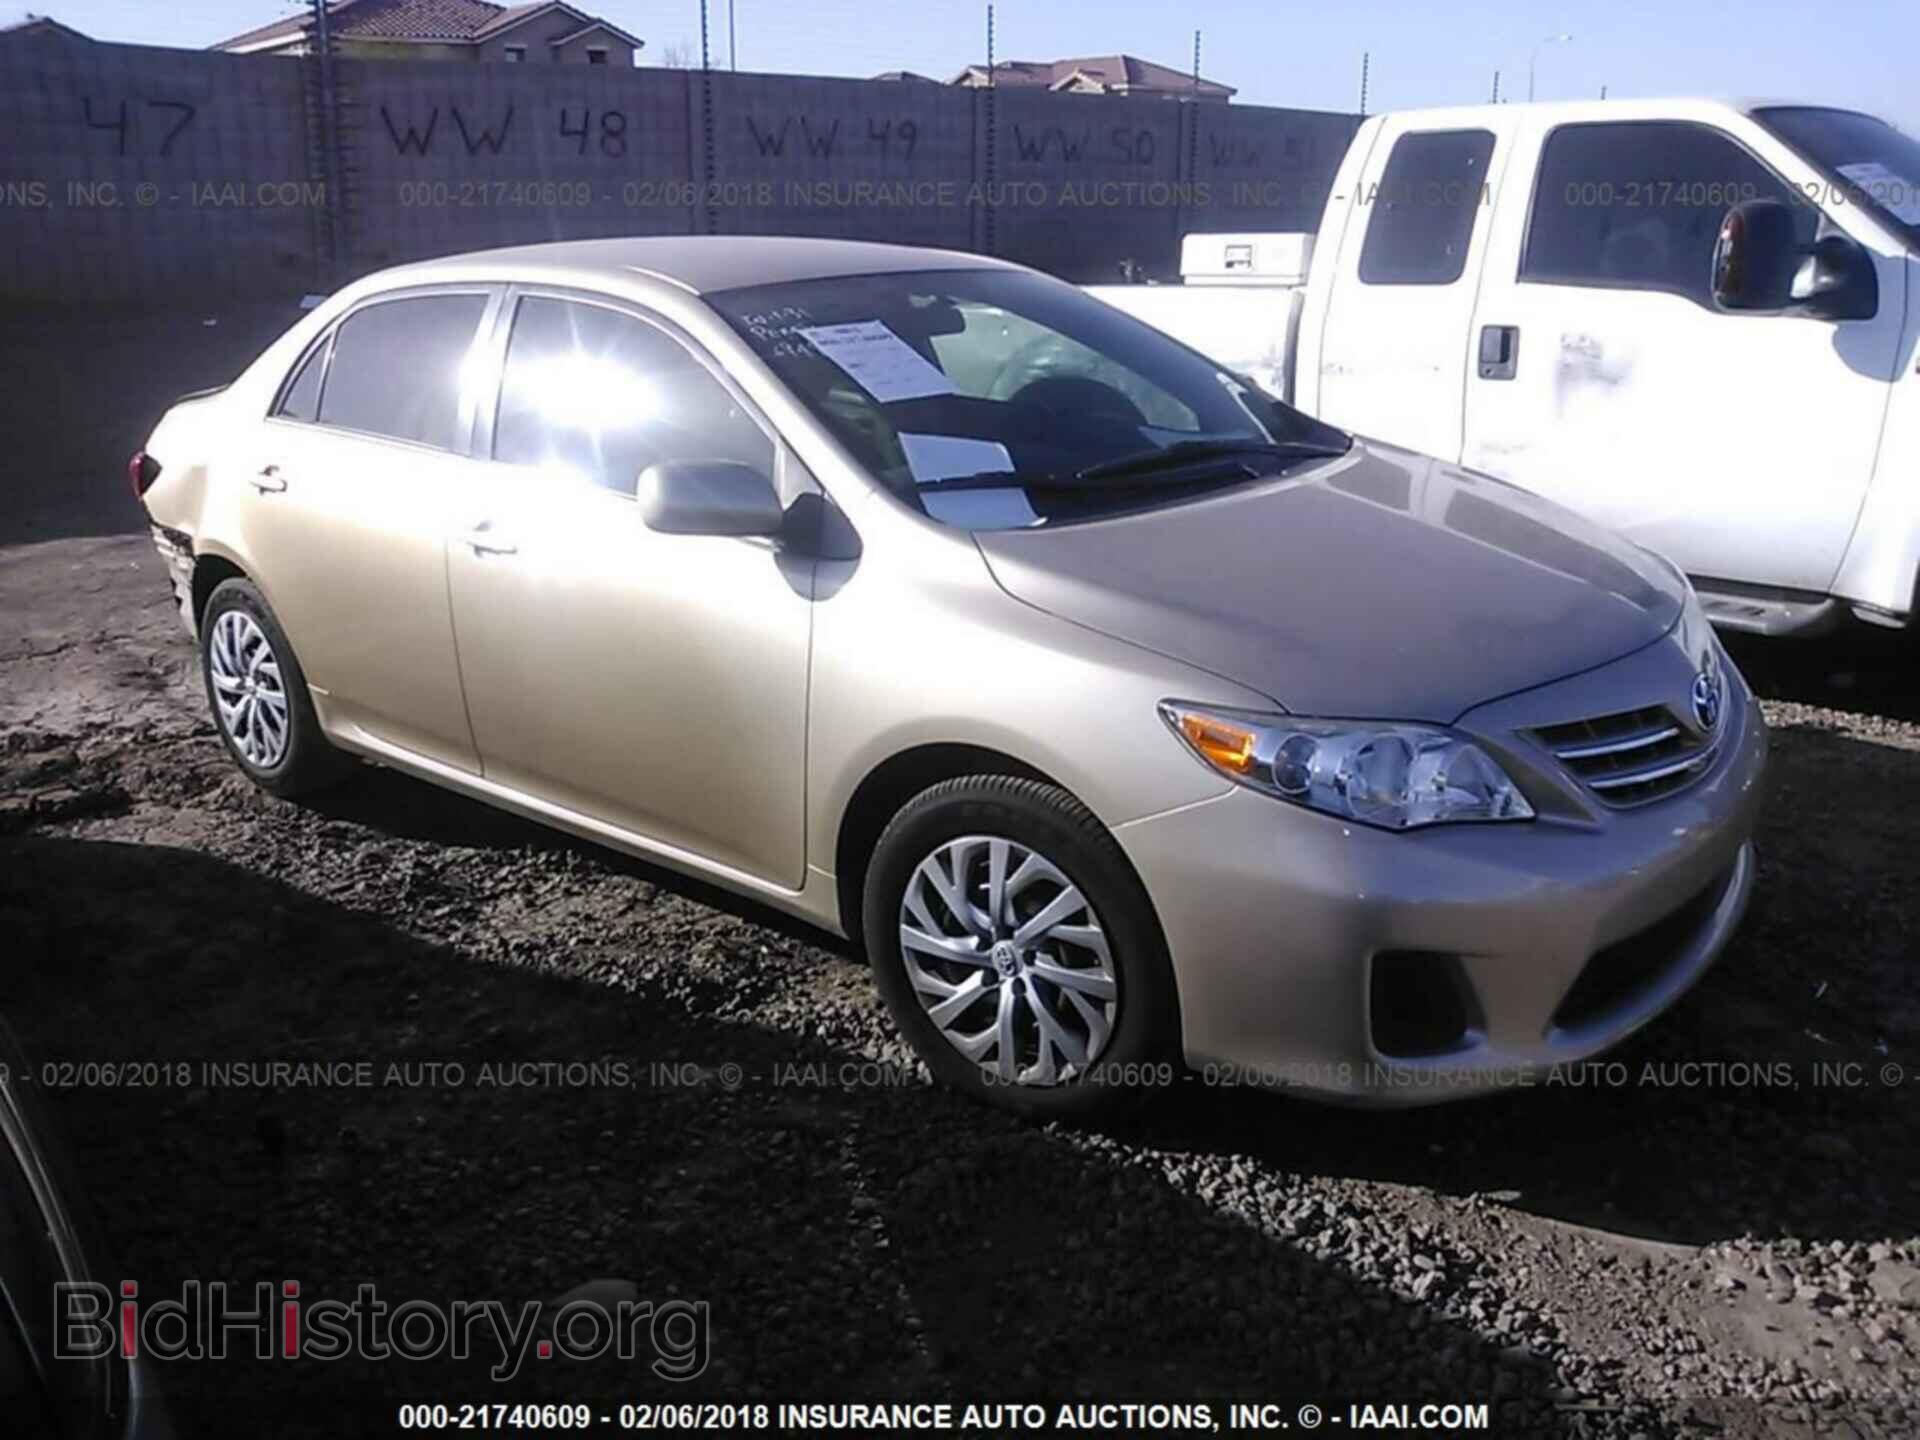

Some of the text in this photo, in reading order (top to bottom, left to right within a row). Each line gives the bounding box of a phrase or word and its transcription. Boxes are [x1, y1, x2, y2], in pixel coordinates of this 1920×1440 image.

[81, 95, 197, 157] 47
[559, 107, 628, 158] 48
[866, 117, 917, 160] 49
[1112, 127, 1154, 165] 50
